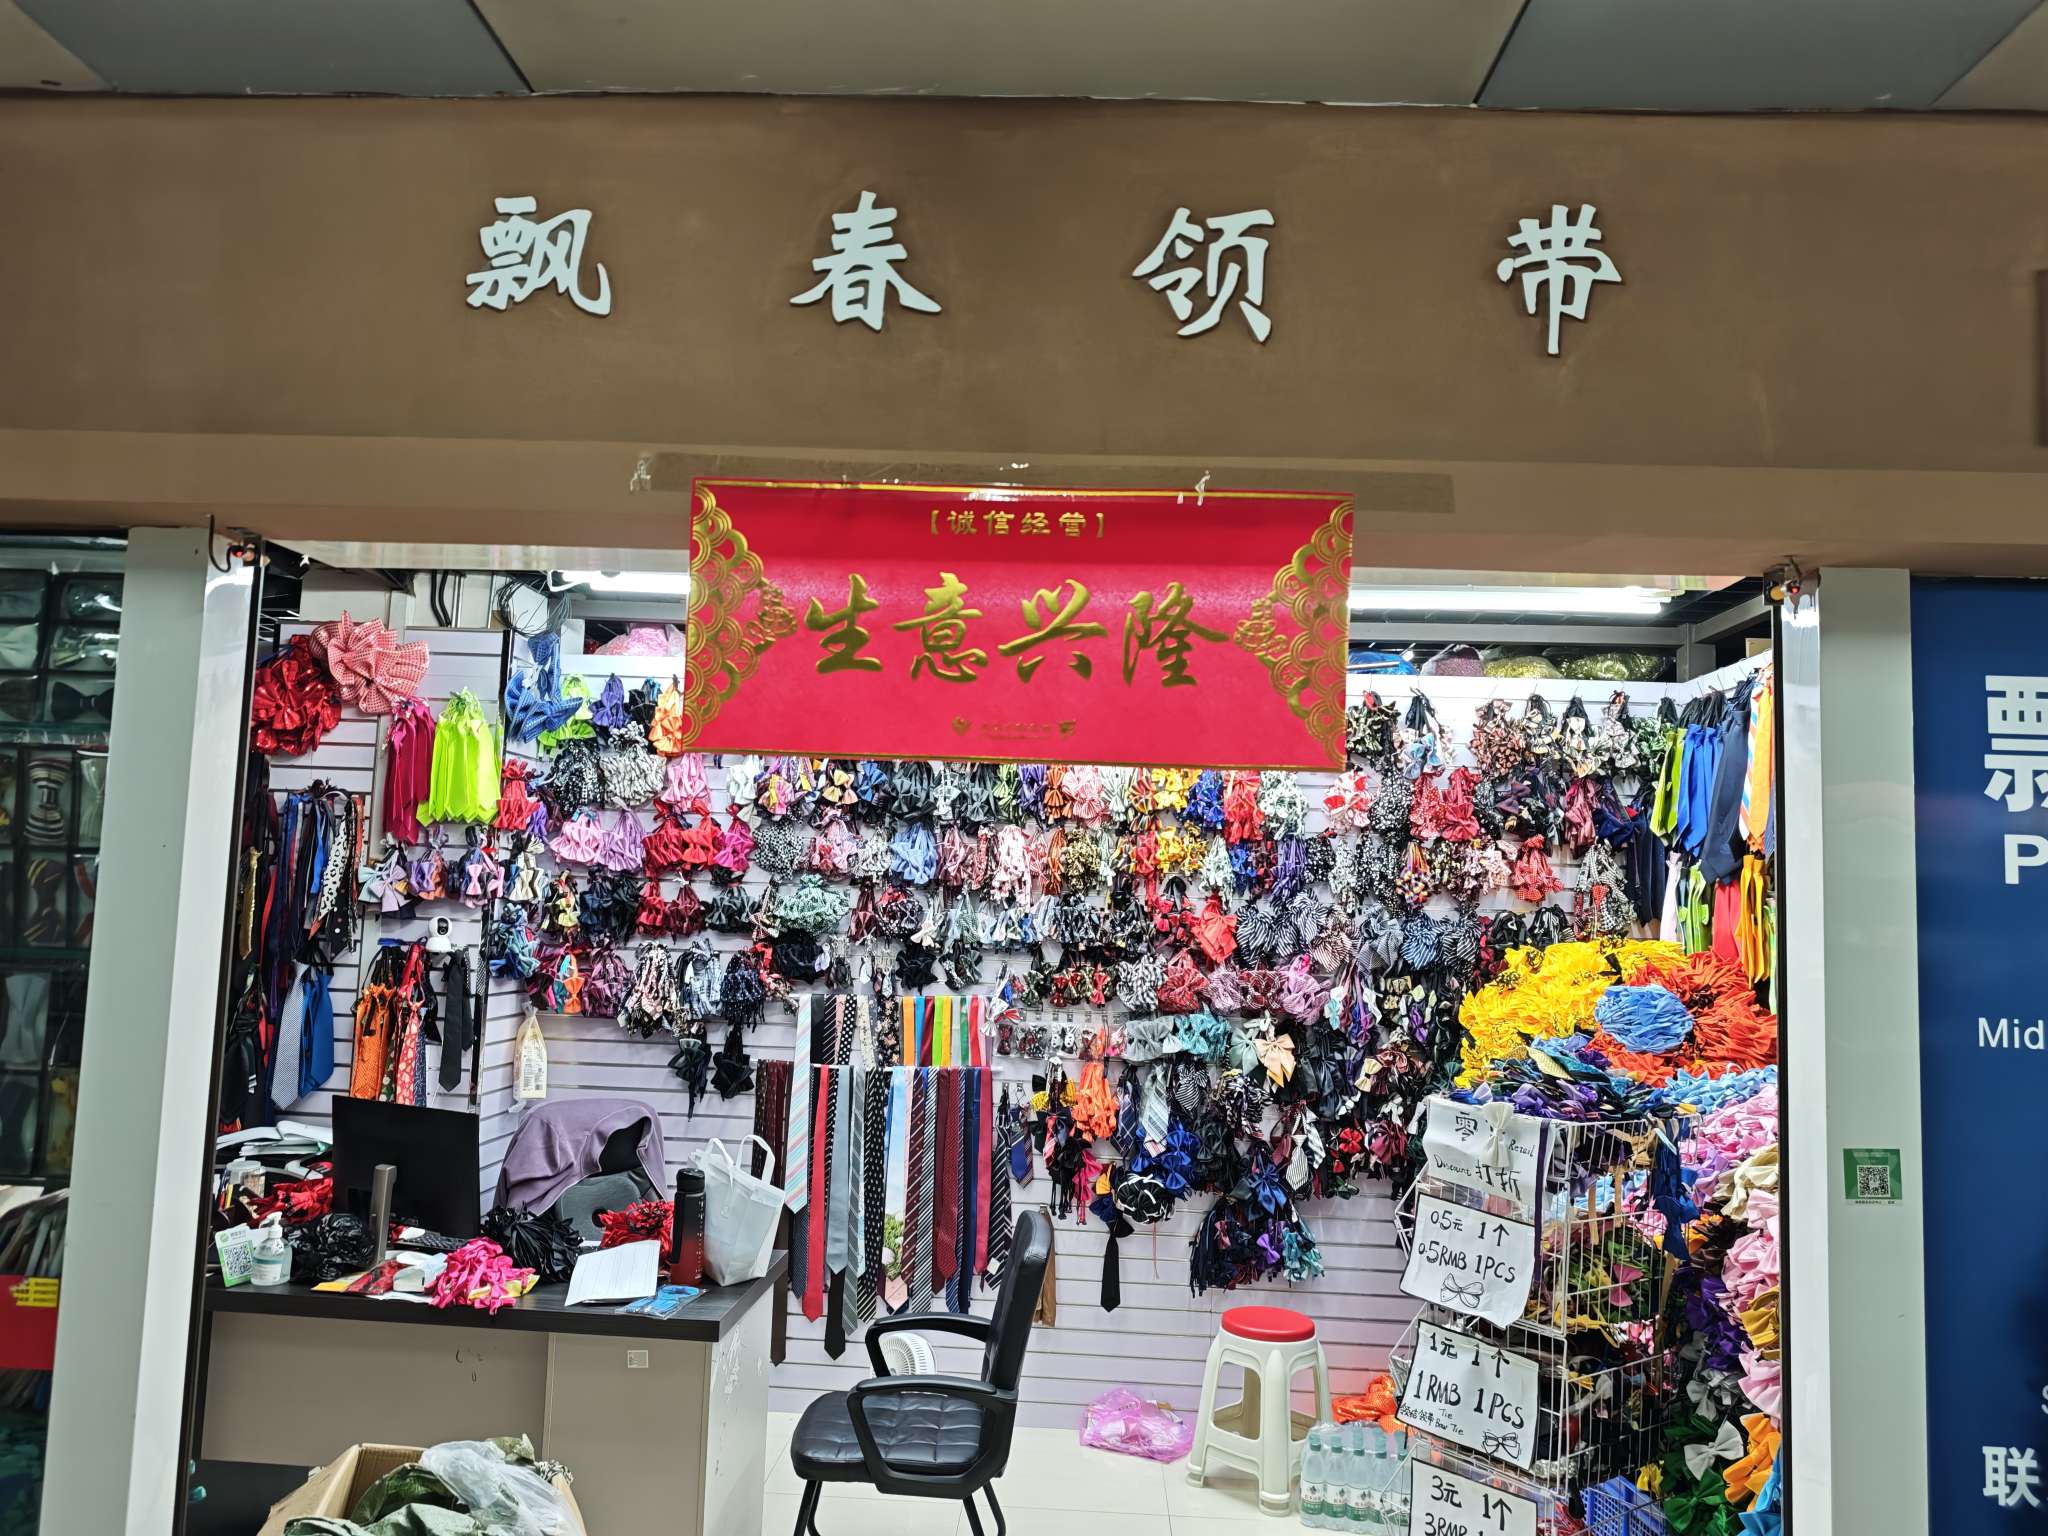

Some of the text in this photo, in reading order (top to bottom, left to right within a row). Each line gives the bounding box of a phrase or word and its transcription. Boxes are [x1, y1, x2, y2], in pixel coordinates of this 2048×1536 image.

[466, 190, 1622, 355] 飘春领带
[803, 571, 1229, 688] 生意兴隆
[1475, 1159, 1522, 1202] 打折
[1430, 1332, 1457, 1359] 1元
[1430, 1475, 1462, 1508] 3元
[1982, 1445, 2041, 1507] 联
